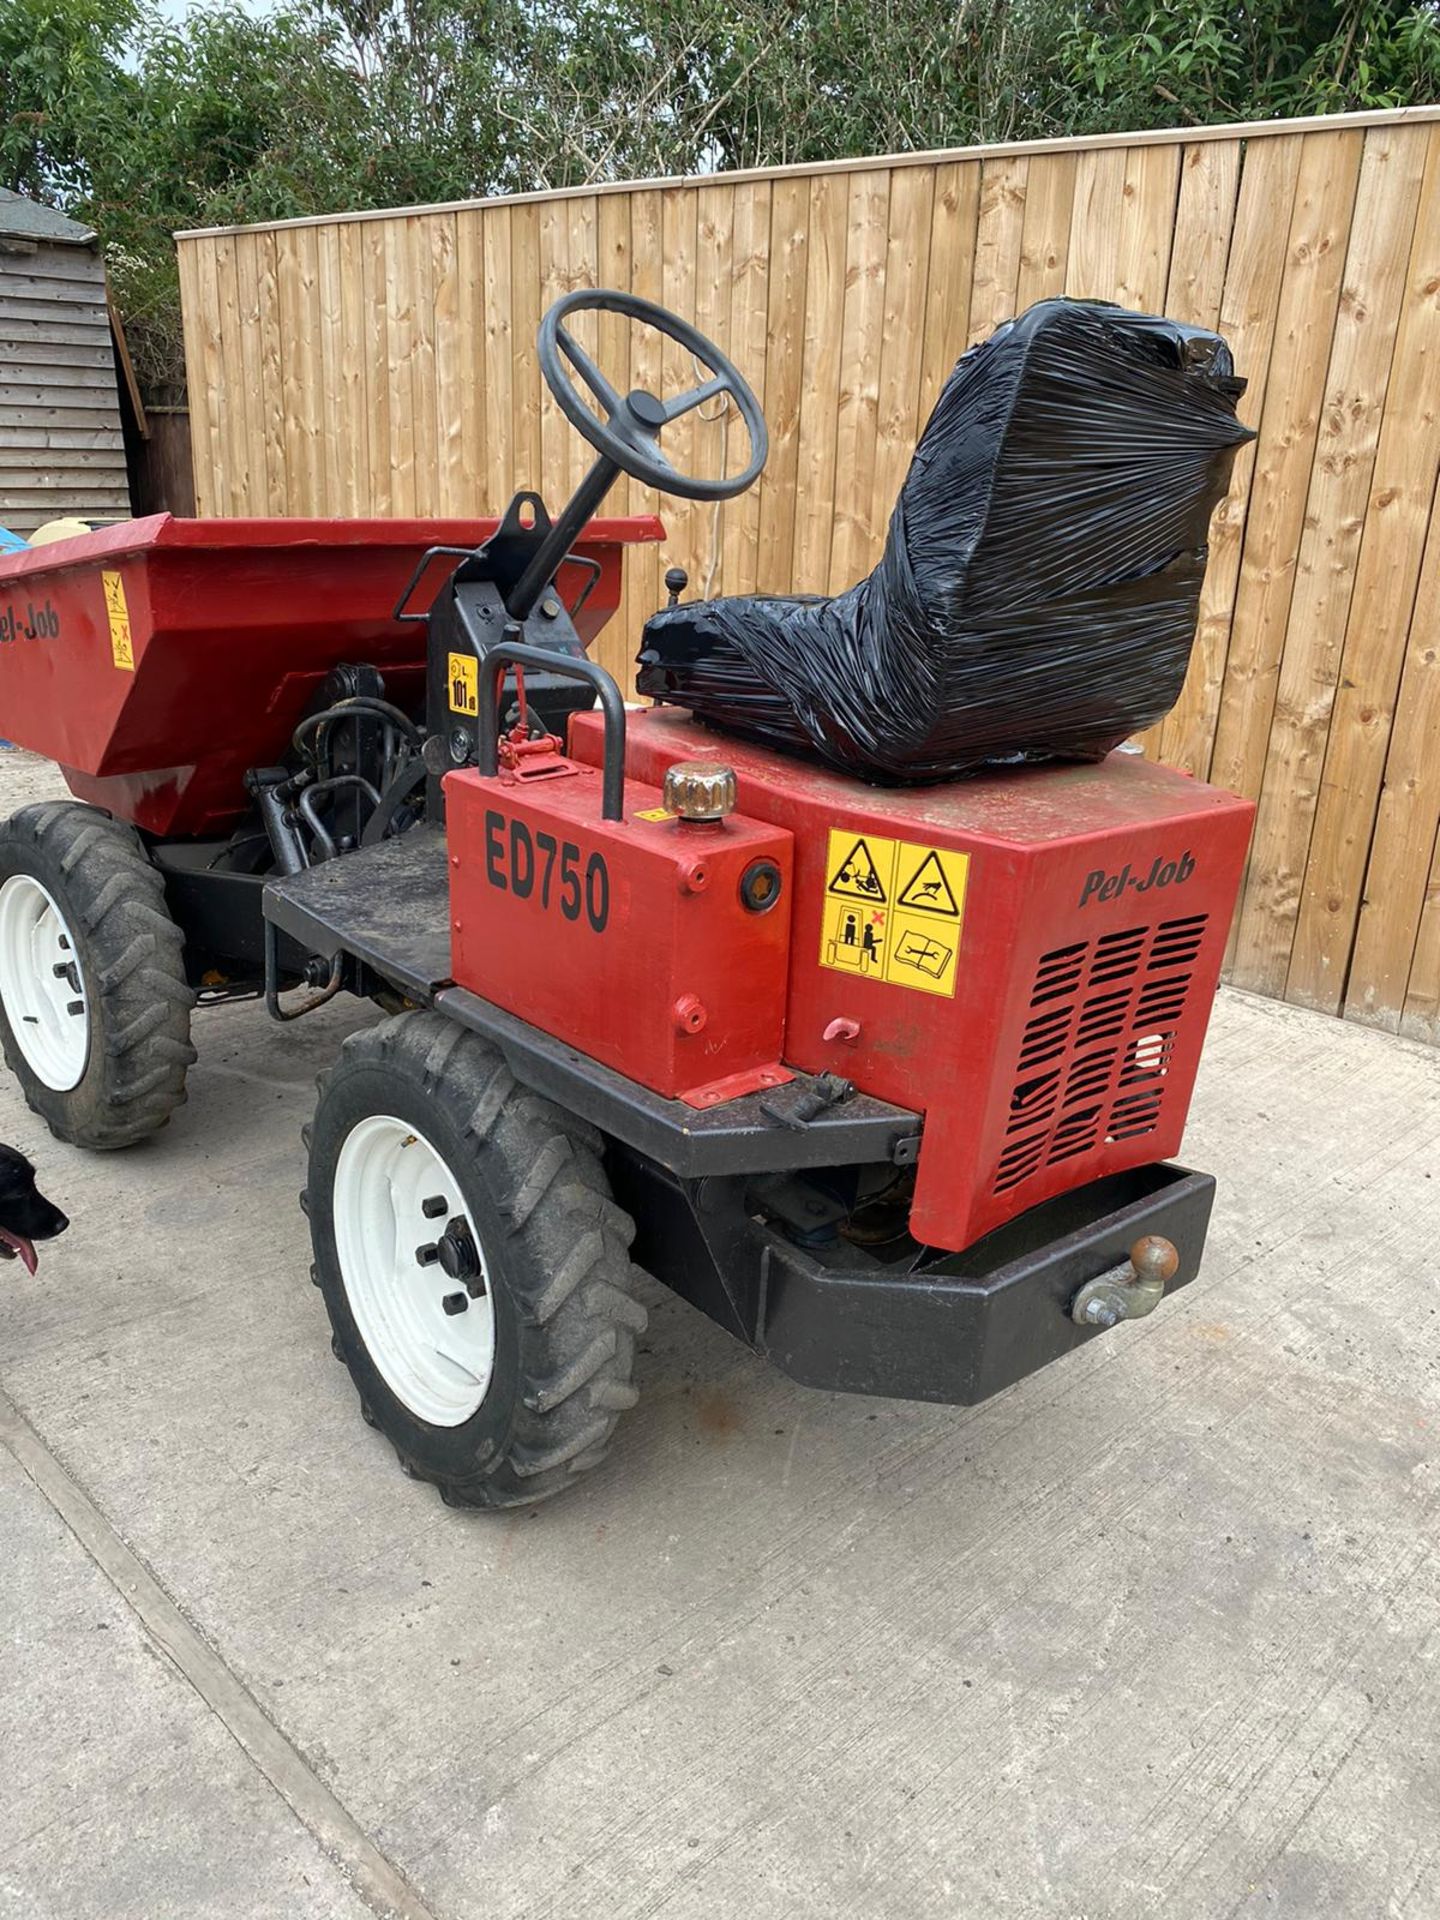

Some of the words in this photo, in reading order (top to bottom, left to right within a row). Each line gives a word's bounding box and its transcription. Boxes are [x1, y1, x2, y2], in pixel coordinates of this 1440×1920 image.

[0, 600, 60, 642] el-Job
[453, 679, 467, 708] 101
[485, 809, 609, 933] ED750
[1078, 849, 1196, 909] Pel-Job
